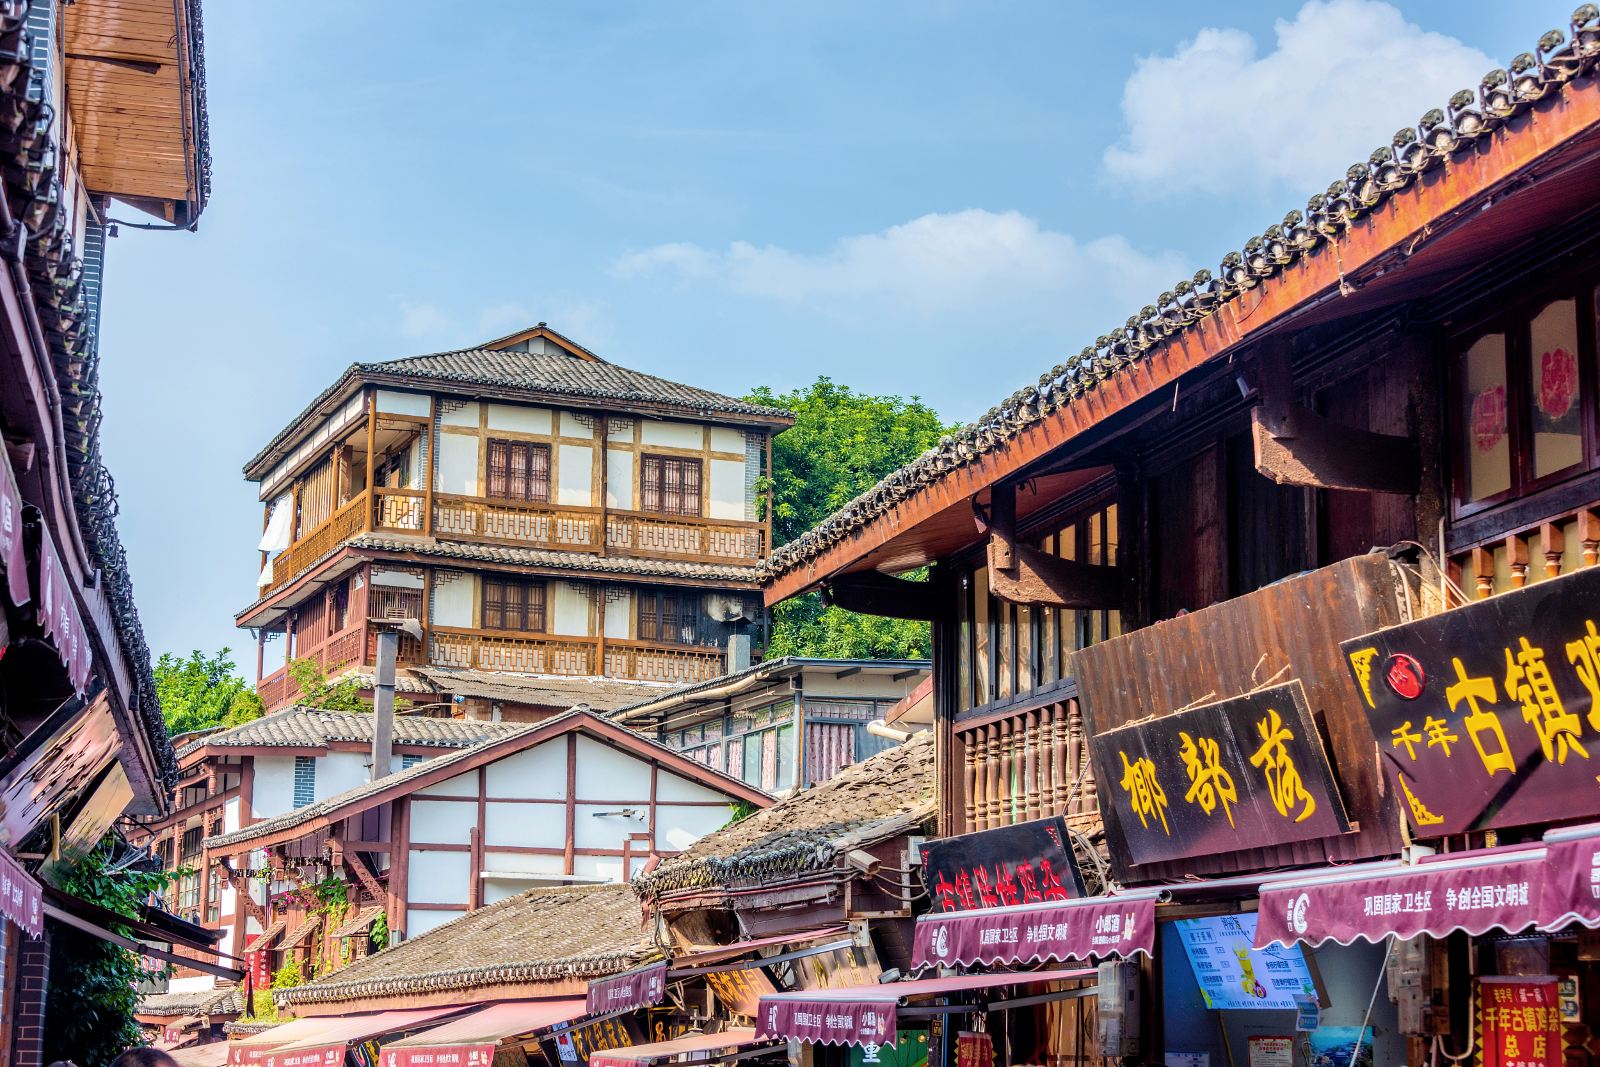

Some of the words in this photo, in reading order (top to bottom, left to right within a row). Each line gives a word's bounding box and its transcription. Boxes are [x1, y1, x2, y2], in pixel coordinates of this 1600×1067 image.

[1392, 715, 1459, 761] 千年
[1119, 708, 1316, 837] 椰部落
[1363, 890, 1432, 917] 巩固国家卫生区
[1445, 882, 1529, 911] 争创全国文明城
[1485, 1006, 1559, 1032] 千年古镇鸡杂
